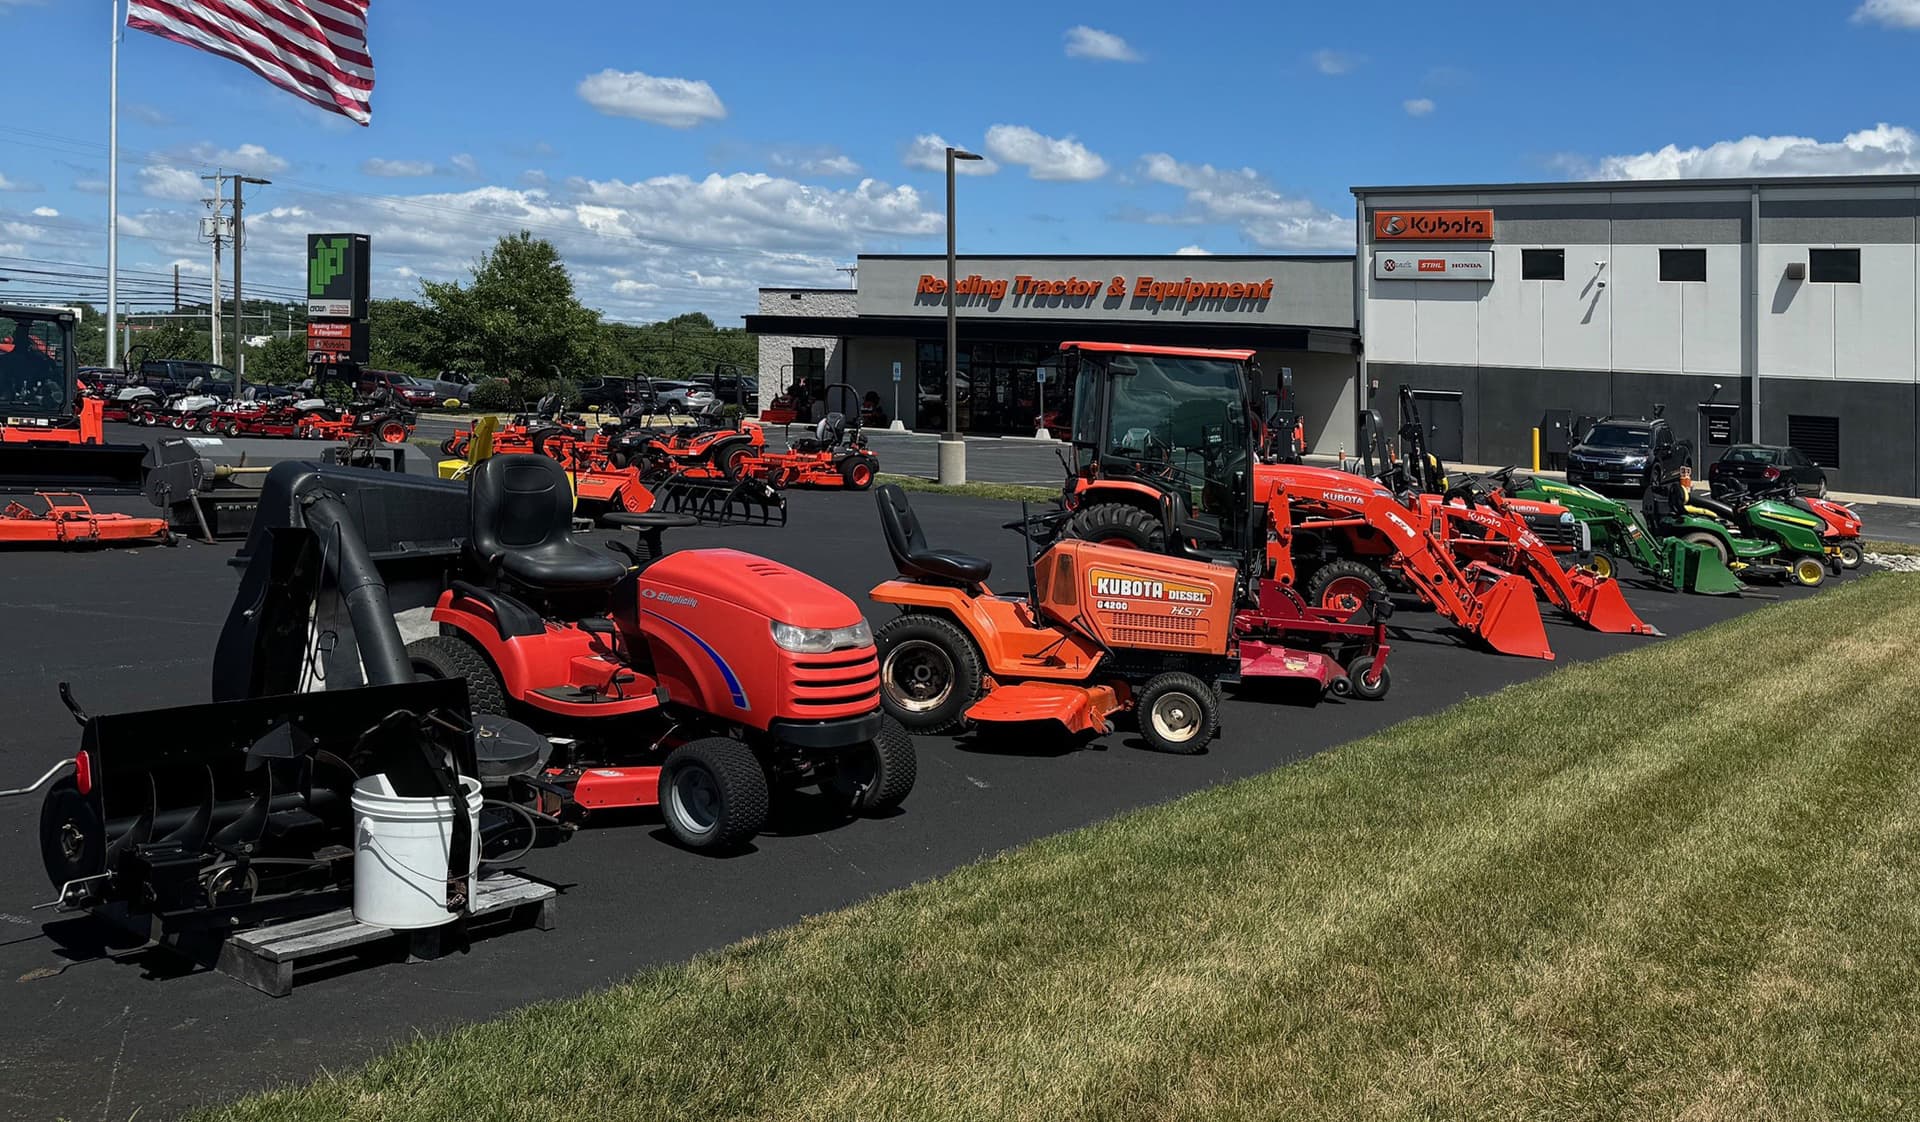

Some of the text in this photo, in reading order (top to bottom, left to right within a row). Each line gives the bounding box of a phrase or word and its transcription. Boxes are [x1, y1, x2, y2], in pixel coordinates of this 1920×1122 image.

[1410, 216, 1484, 234] Kubota
[1012, 275, 1101, 297] Tractor
[1106, 276, 1127, 297] &
[1134, 277, 1275, 303] Equipment
[1322, 491, 1365, 505] KUBOTA
[1467, 511, 1502, 527] Kubota
[1097, 578, 1206, 602] KUBOTA DIESEL
[656, 591, 698, 609] Simplicity
[1170, 606, 1204, 617] HST
